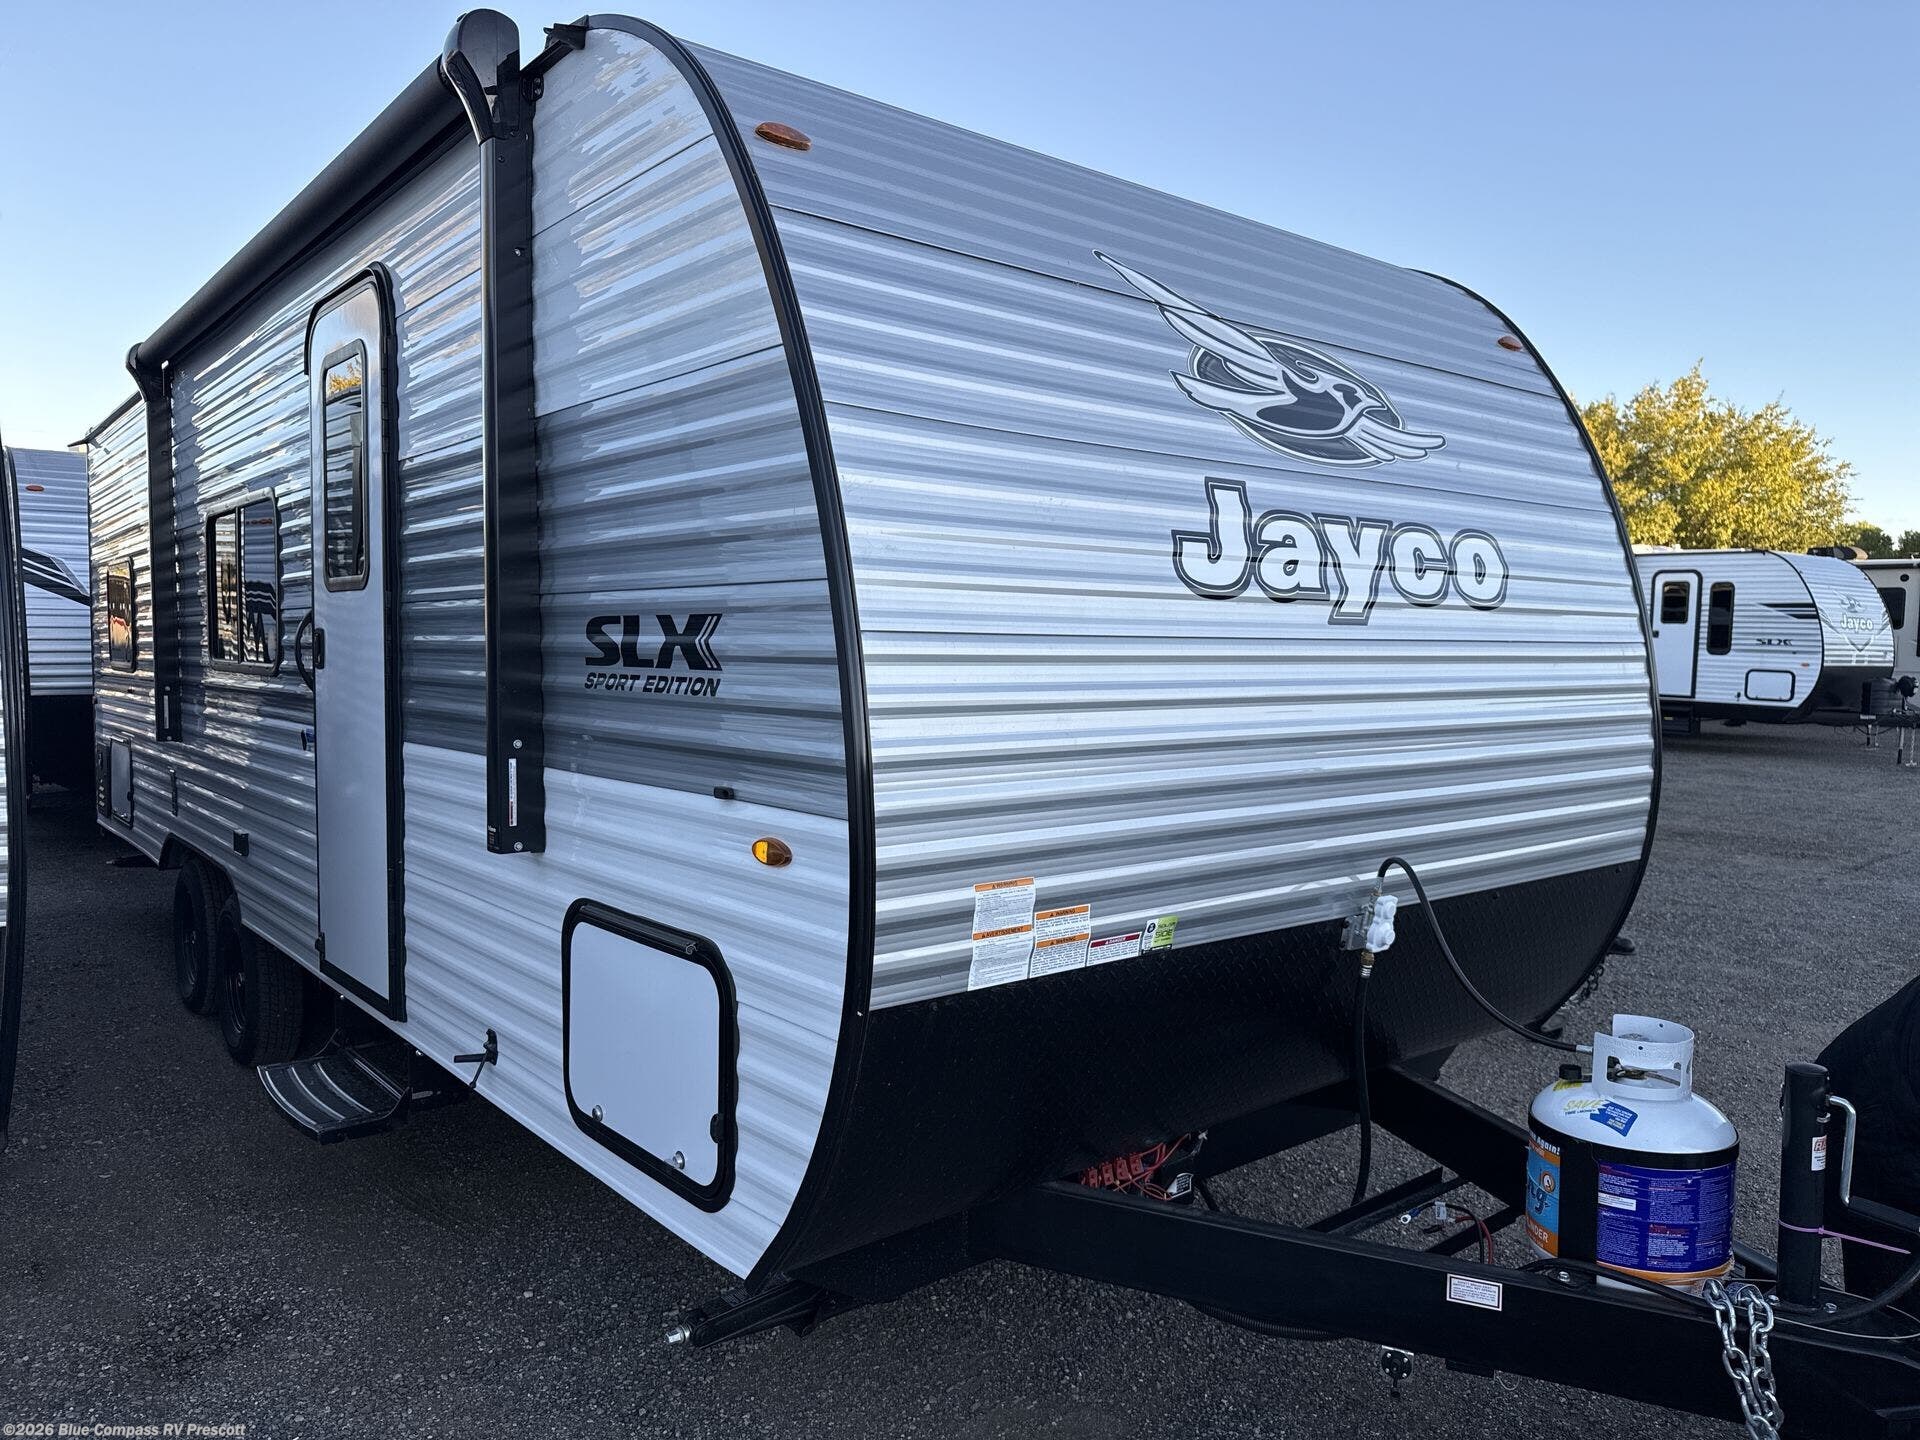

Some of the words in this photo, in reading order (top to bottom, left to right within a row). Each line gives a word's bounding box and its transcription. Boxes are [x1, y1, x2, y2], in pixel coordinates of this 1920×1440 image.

[1171, 476, 1508, 625] Jayco
[1840, 614, 1874, 634] Jayco
[585, 614, 722, 670] SLX
[584, 672, 640, 691] SPORT
[642, 675, 721, 696] EDITION
[1536, 1136, 1561, 1155] Again!
